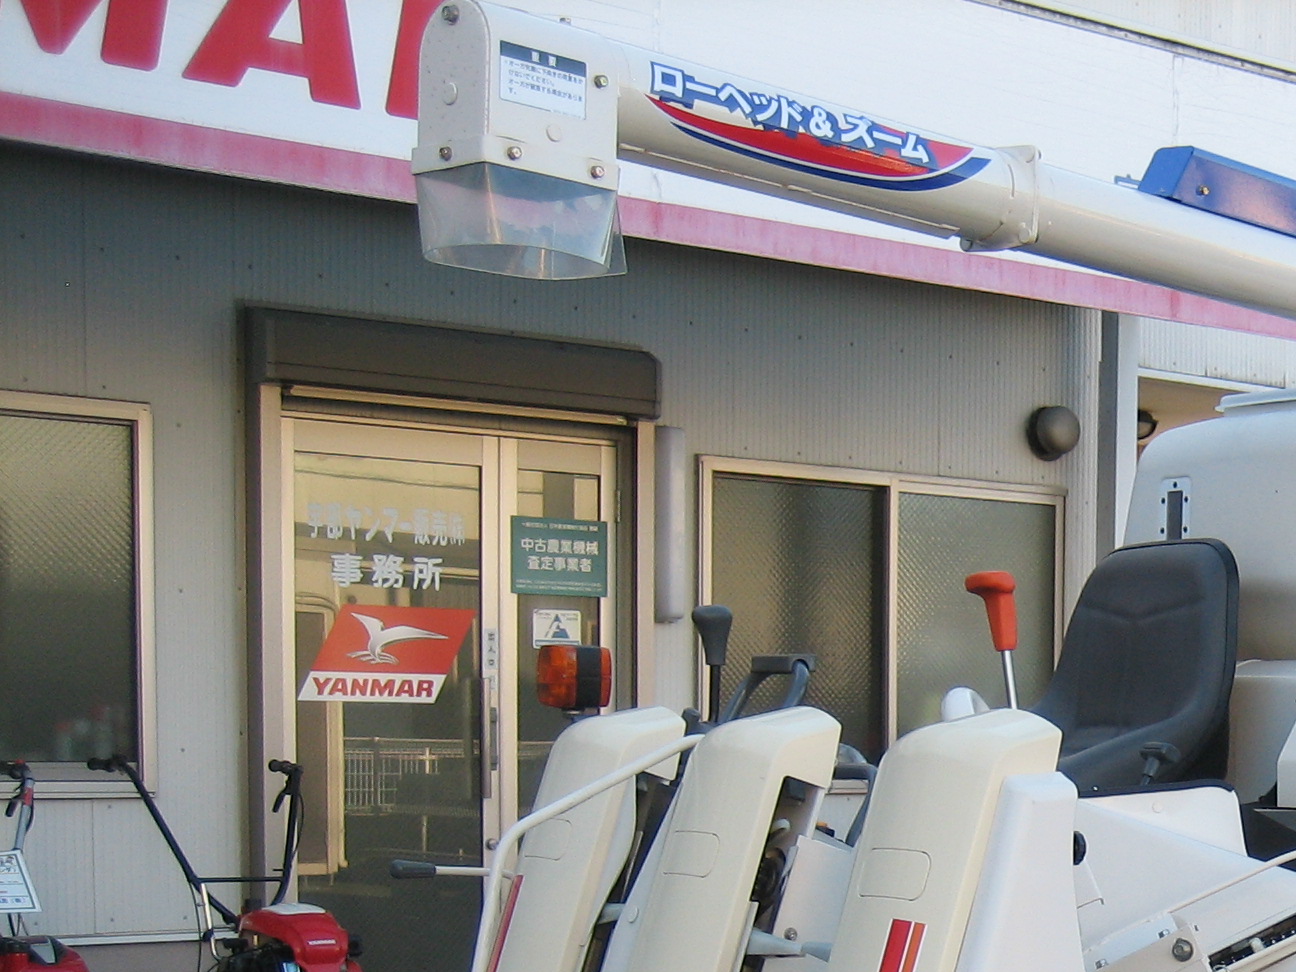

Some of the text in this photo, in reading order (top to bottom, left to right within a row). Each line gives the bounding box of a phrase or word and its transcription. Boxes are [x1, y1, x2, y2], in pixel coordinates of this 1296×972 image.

[331, 553, 444, 591] 事務所
[312, 676, 435, 698] YANMAR
